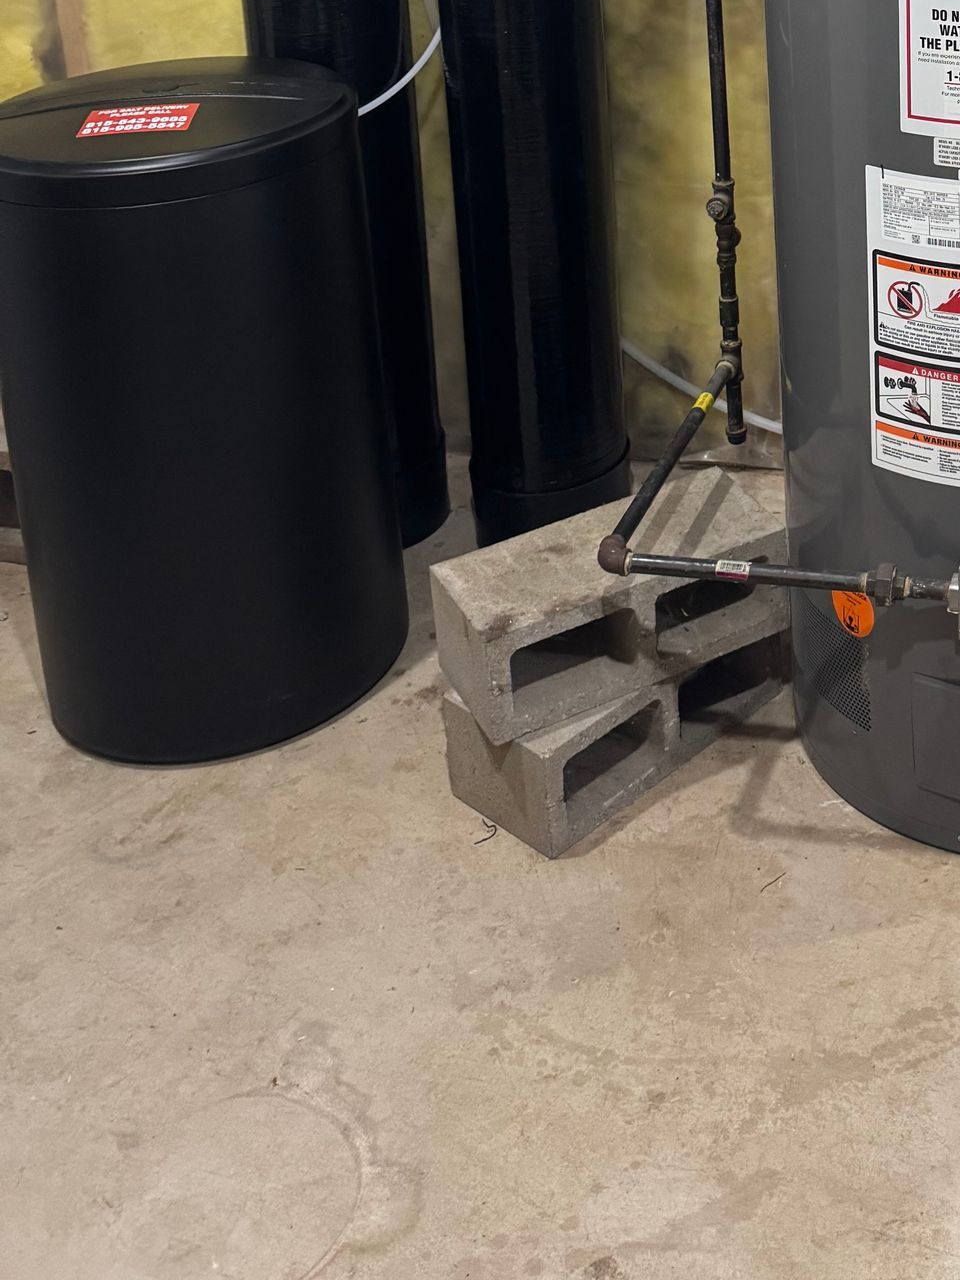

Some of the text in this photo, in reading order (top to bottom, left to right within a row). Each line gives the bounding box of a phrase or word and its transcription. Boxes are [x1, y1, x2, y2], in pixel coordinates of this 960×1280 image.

[932, 9, 947, 21] DO
[920, 37, 941, 50] THE
[927, 324, 950, 332] EXPLOSION
[922, 370, 959, 381] DANGER
